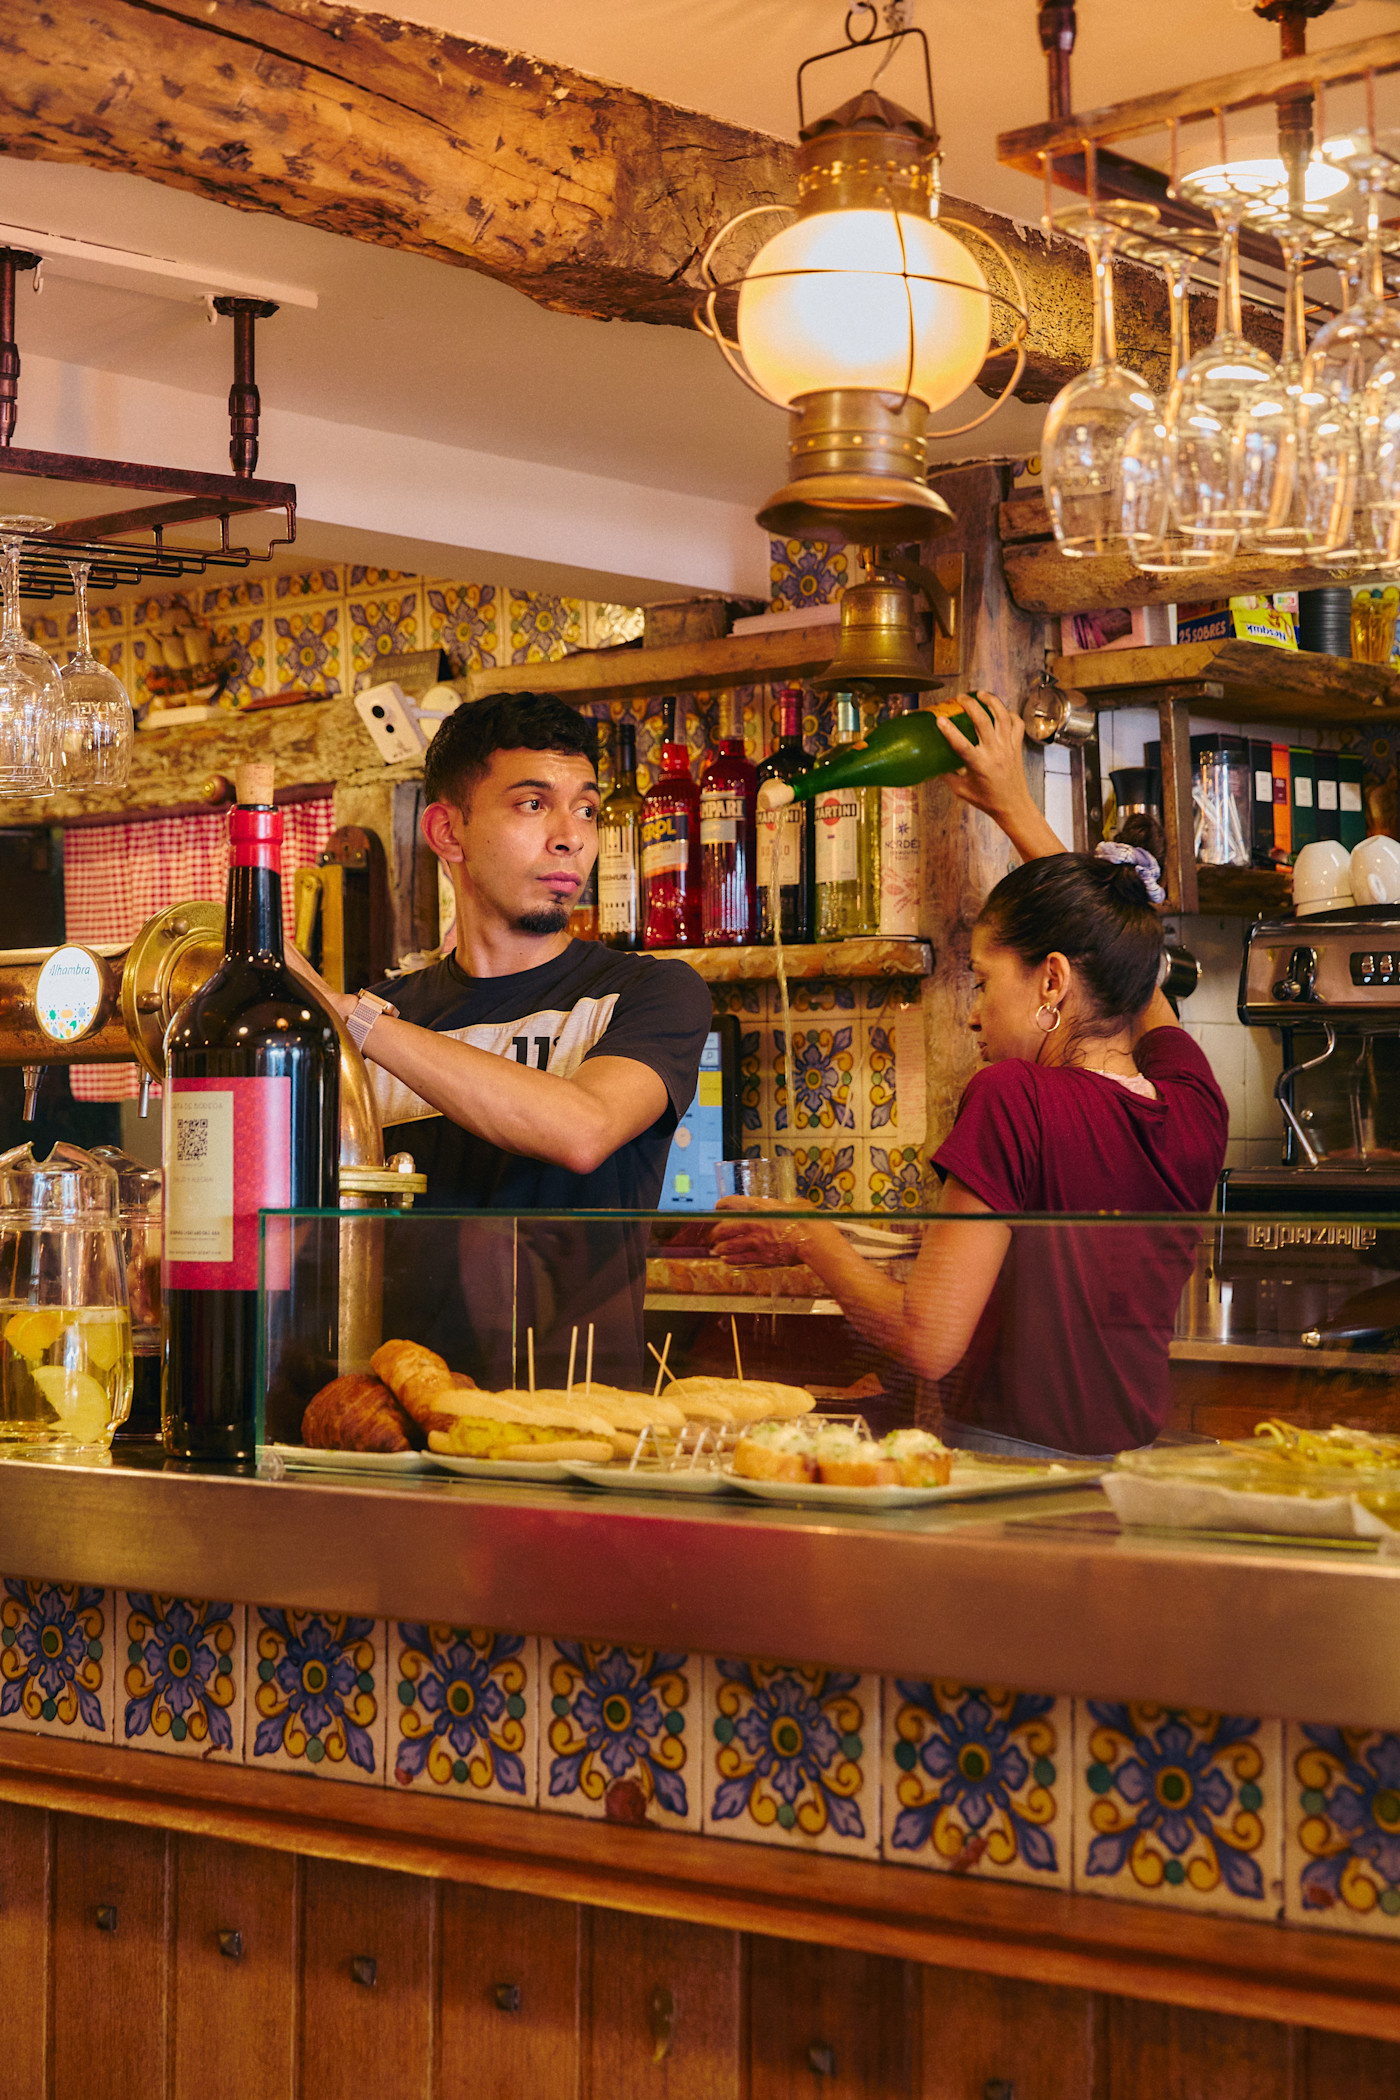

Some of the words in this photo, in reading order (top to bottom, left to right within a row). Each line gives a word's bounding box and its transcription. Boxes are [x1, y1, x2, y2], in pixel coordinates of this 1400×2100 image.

[1179, 628, 1191, 644] 25
[1192, 620, 1226, 643] SOBRES
[1246, 625, 1286, 641] Nesquik
[701, 799, 743, 818] MPARI
[757, 809, 801, 824] MARTNI
[815, 804, 857, 820] MARTINI
[641, 818, 677, 843] EROL
[49, 963, 91, 976] Alhambra
